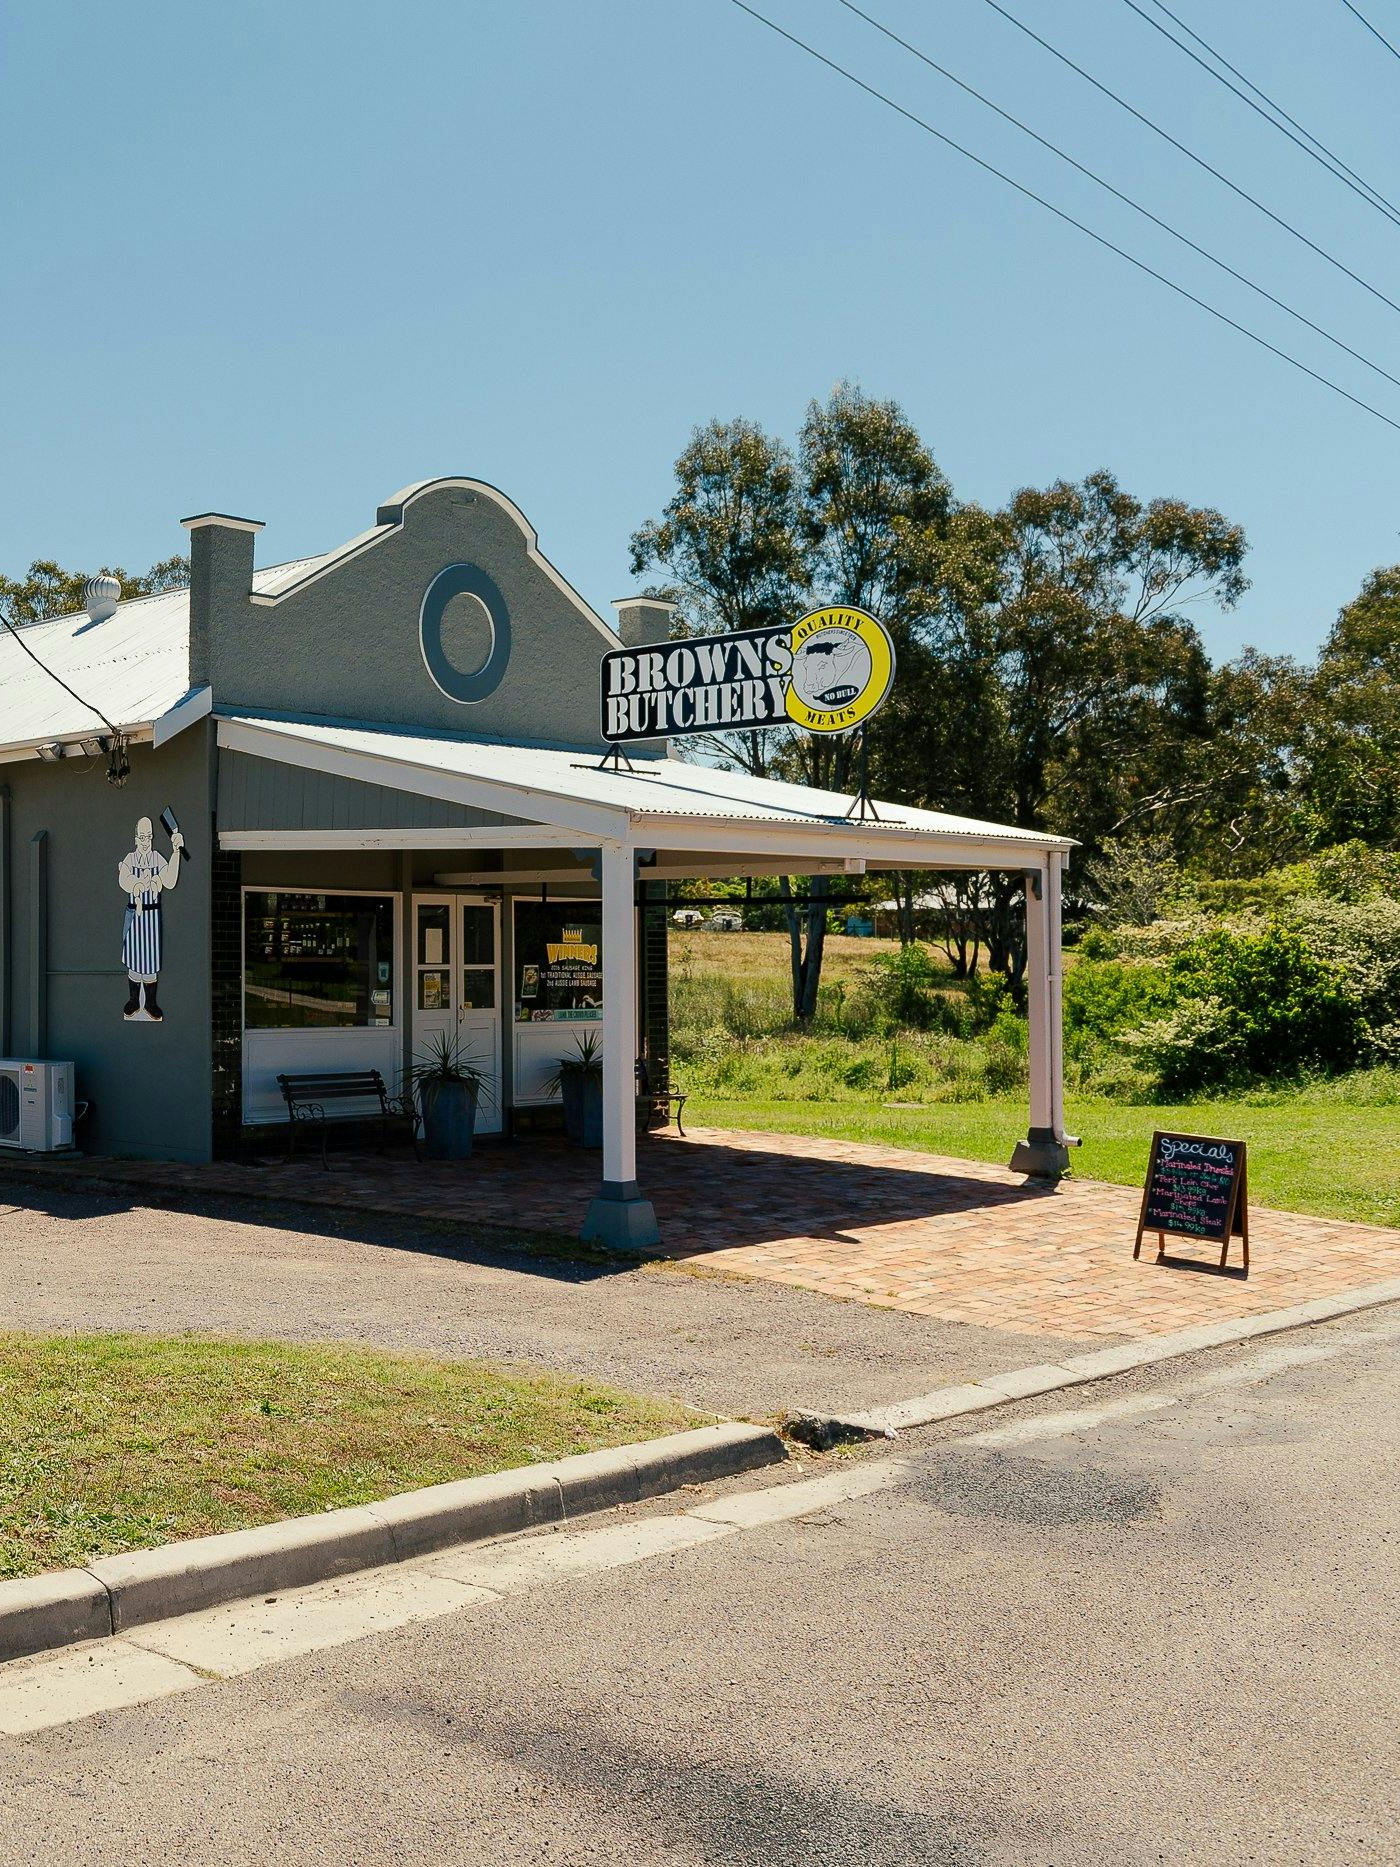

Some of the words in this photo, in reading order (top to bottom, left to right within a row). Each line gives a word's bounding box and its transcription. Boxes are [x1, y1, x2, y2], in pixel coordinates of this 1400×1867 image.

[797, 614, 864, 639] QUALITY
[608, 634, 794, 696] BROWNS
[824, 692, 836, 702] NO
[836, 687, 857, 699] BULL
[606, 675, 794, 735] BUTCHERY
[804, 707, 856, 726] MEATS
[546, 943, 597, 965] WINNERS
[569, 979, 580, 987] LAMB
[1161, 1139, 1233, 1163] Specials
[1161, 1159, 1202, 1171] Marinated
[1160, 1175, 1177, 1184] Pork
[1156, 1188, 1203, 1202] Marinated
[1153, 1209, 1196, 1222] Marinated
